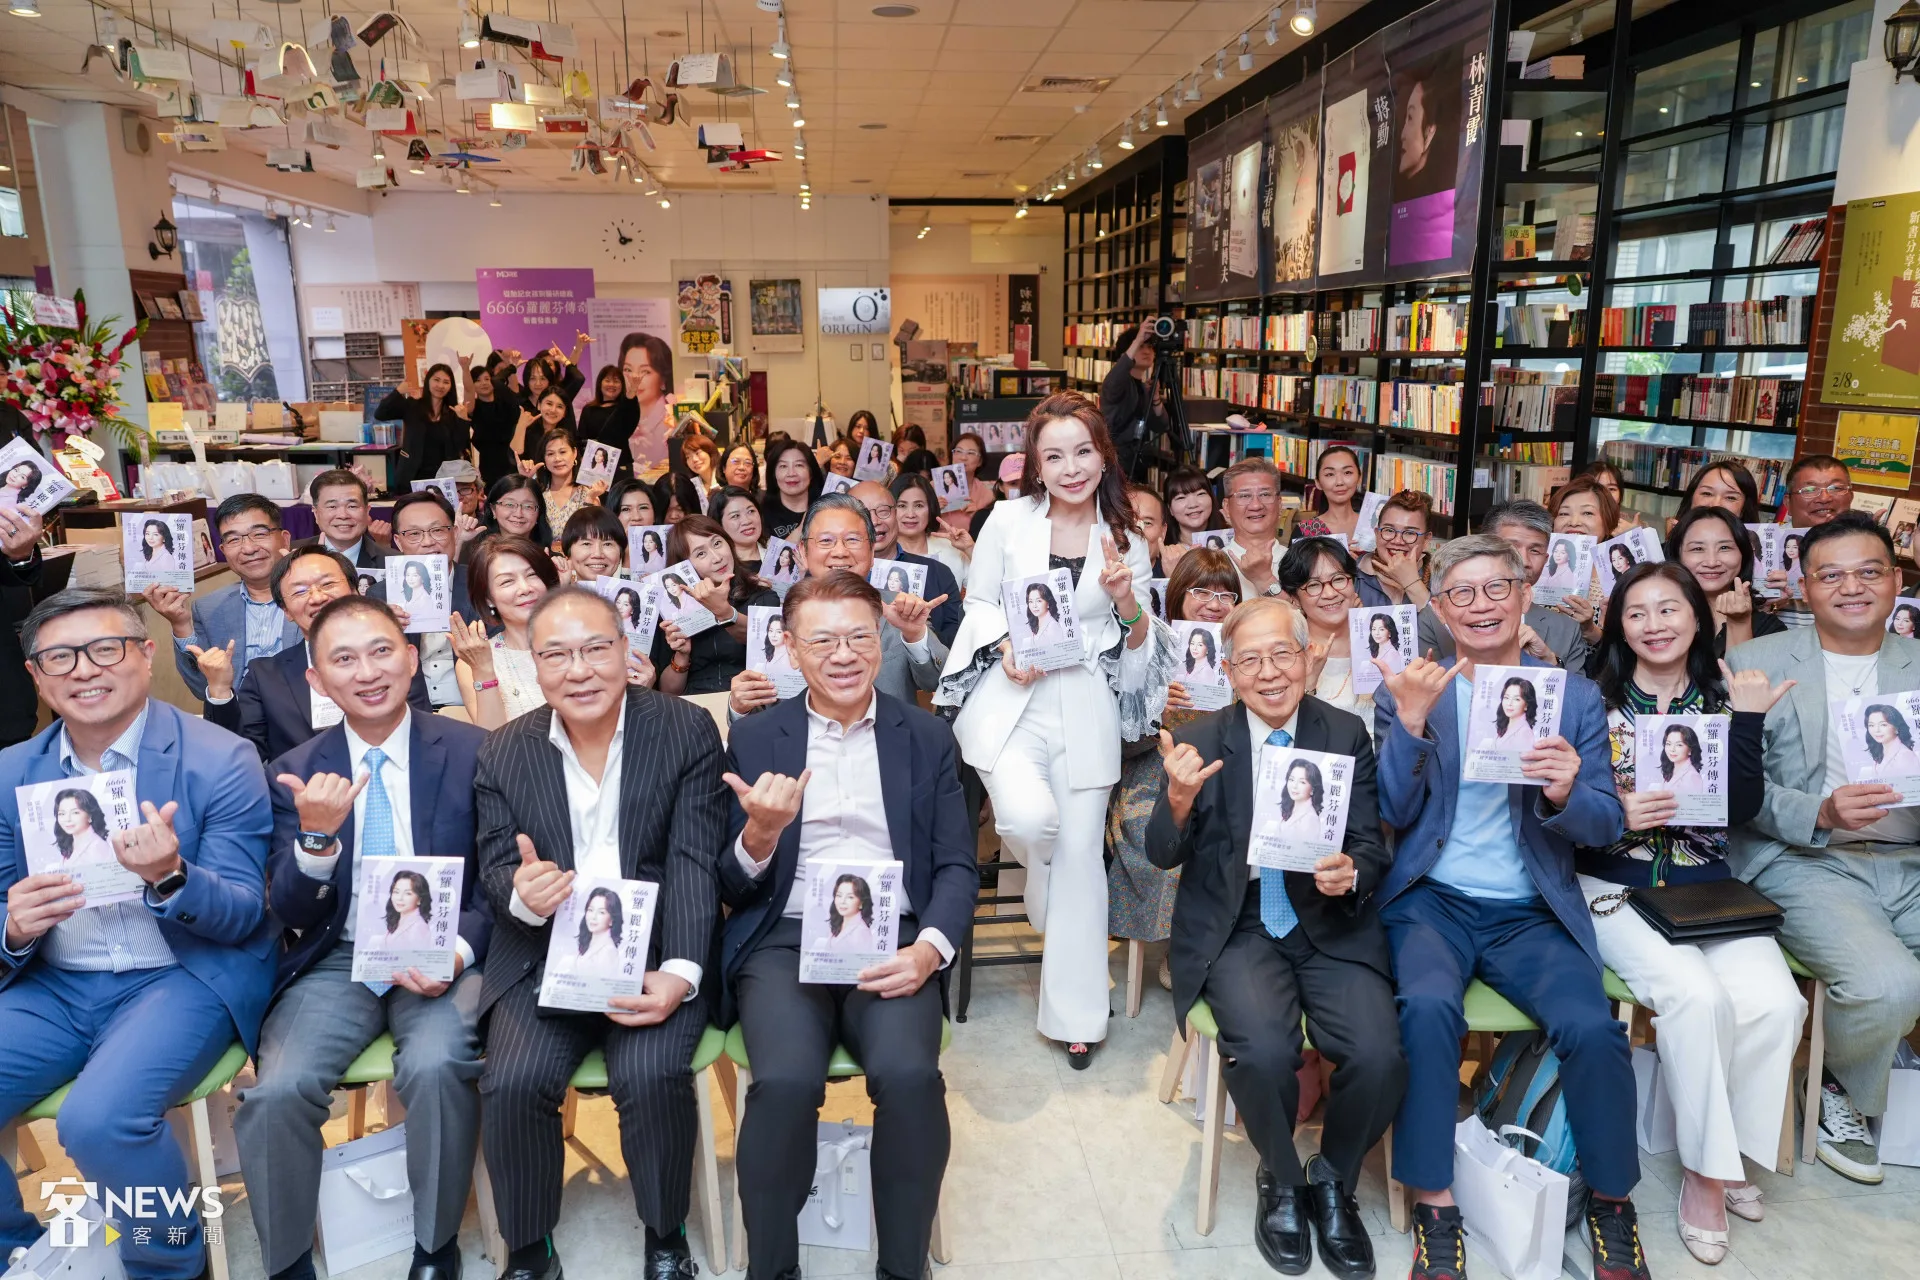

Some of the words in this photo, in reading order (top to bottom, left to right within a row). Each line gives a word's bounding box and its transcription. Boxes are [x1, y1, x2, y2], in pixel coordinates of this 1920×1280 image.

[1466, 52, 1485, 147] 林青霞
[1903, 210, 1920, 282] 新書分享會
[822, 323, 872, 334] ORIGIN
[1832, 371, 1852, 388] 2/8
[1057, 582, 1074, 639] 羅麗芬傳奇
[1539, 683, 1556, 738] 羅麗芬傳
[1707, 728, 1719, 794] 羅麗芬傳奇
[111, 787, 130, 831] 羅麗芬
[1323, 769, 1343, 842] 羅麗芬傳奇
[435, 877, 452, 947] 羅麗芬傳奇
[623, 897, 645, 976] 羅麗芬傳奇
[877, 881, 892, 952] 羅麗芬傳奇
